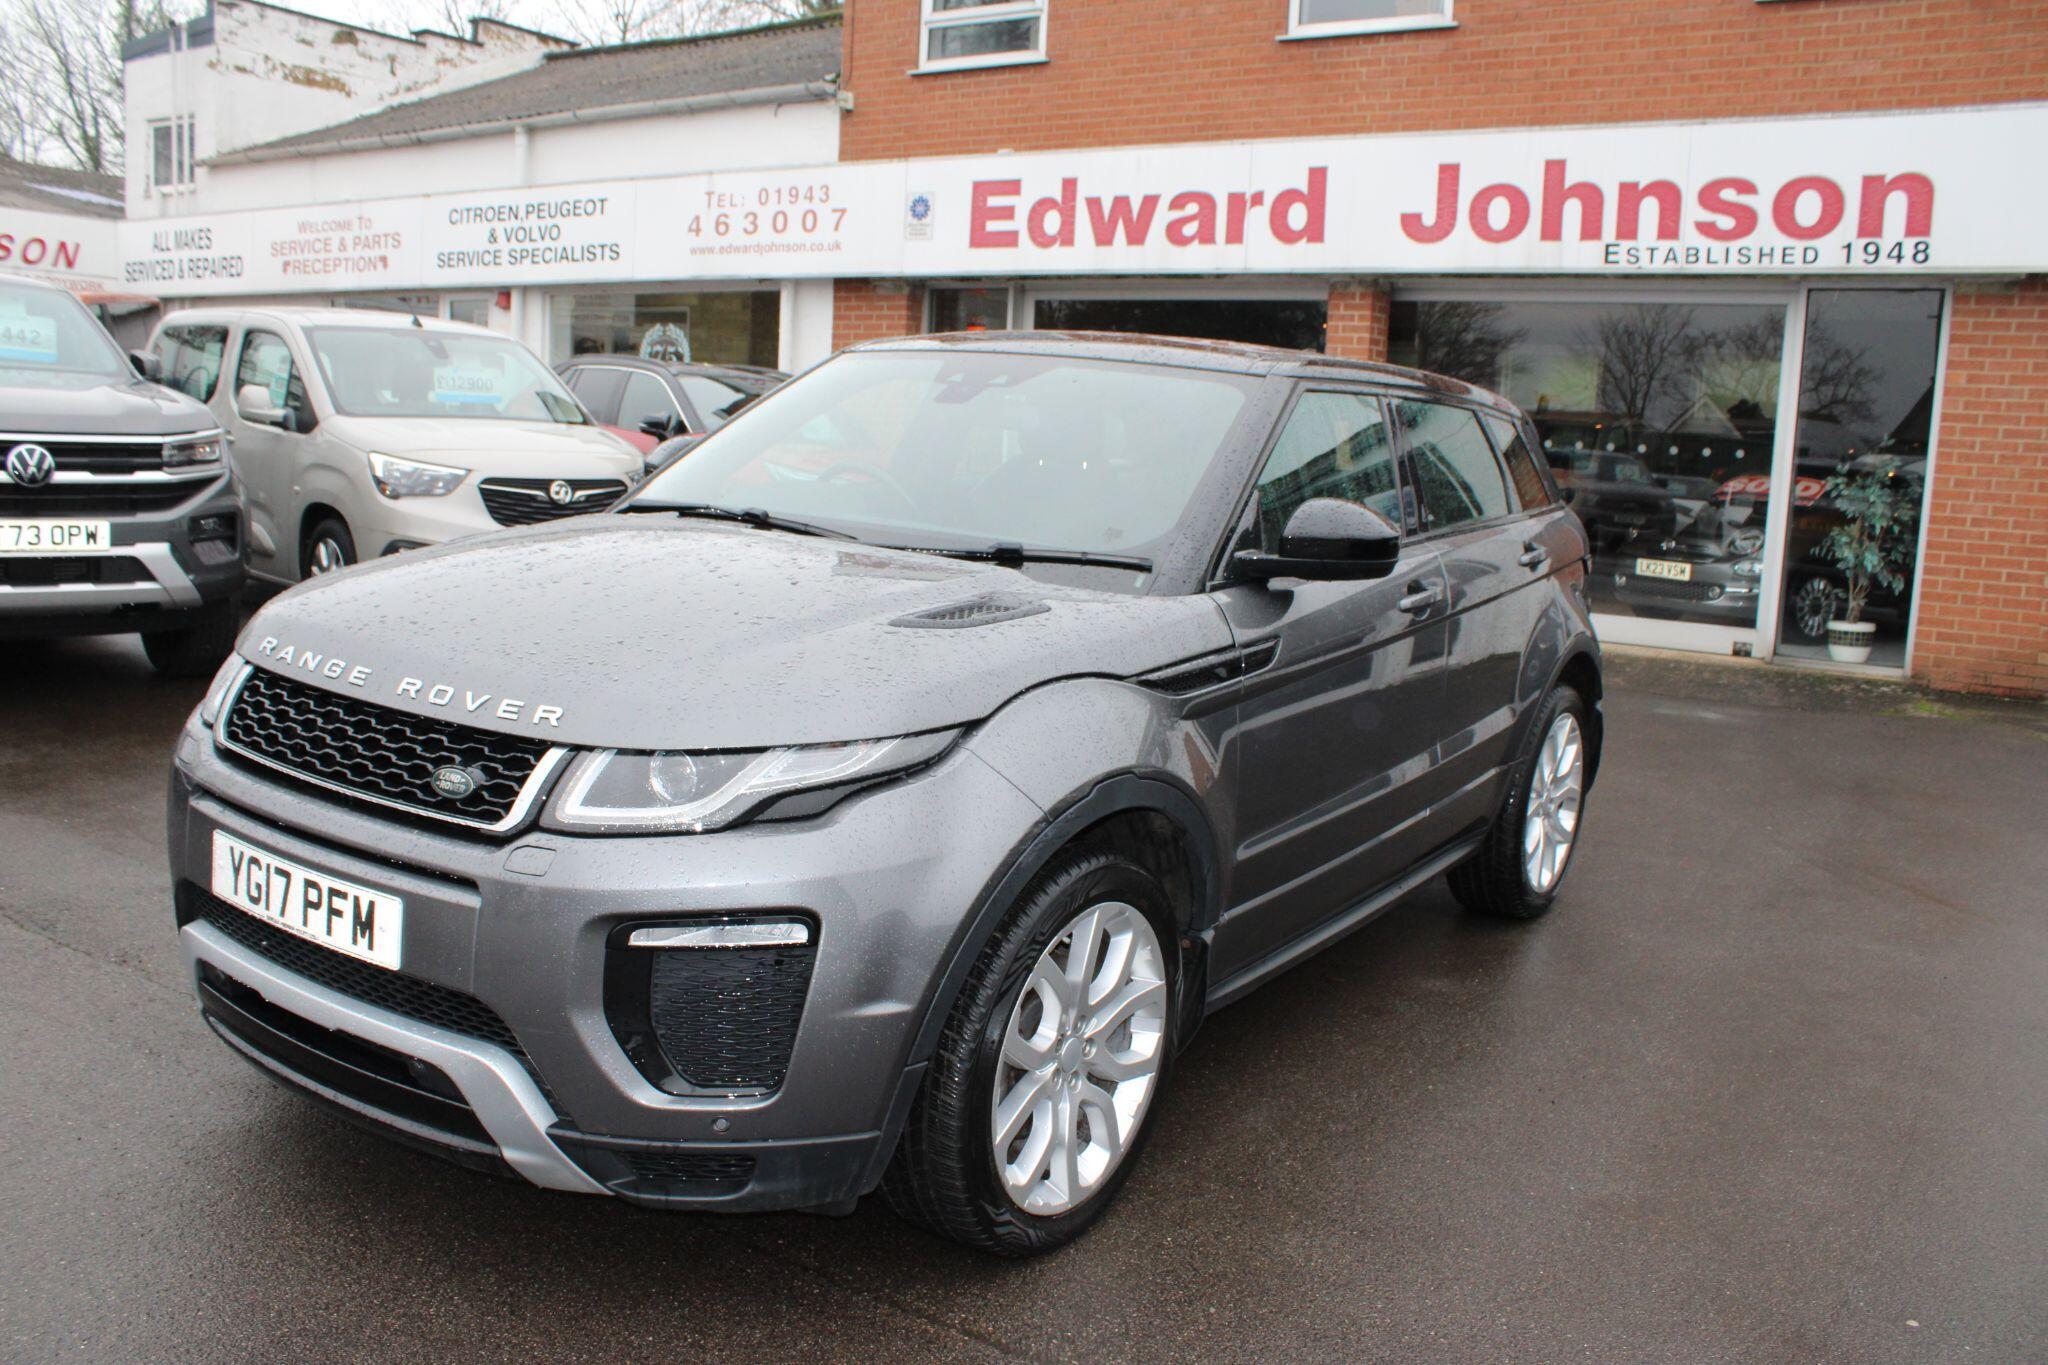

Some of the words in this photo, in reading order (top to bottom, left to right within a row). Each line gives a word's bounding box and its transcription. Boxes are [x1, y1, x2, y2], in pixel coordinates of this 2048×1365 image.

[757, 184, 830, 206] 01943
[969, 165, 1328, 249] Edward
[1399, 158, 1935, 244] Johnson
[297, 219, 354, 234] WELCOME
[357, 215, 372, 231] TO
[488, 227, 498, 244] &
[504, 223, 561, 244] VOLVO
[687, 208, 848, 237] 463007
[153, 229, 171, 252] ALL
[173, 227, 212, 250] MAKES
[271, 238, 333, 257] SERVICE
[337, 236, 348, 253] &
[353, 231, 402, 252] PARTS
[689, 240, 843, 257] www.edwardjohnson.co.uk
[292, 255, 378, 275] RECEPTION
[436, 250, 502, 269] SERVICE
[508, 243, 621, 267] SPECIALISTS
[1603, 242, 1819, 265] ESTABLISHED
[1841, 240, 1932, 265] 1948
[125, 260, 175, 282] SERVICED
[178, 258, 185, 279] &
[188, 255, 244, 279] REPAIRED
[1721, 477, 1822, 496] SOD
[0, 525, 41, 546] 73
[51, 525, 98, 546] OPW
[259, 636, 373, 687] RANGE
[397, 676, 565, 728] ROVER
[229, 845, 292, 919] YG17
[303, 877, 376, 952] PFM
